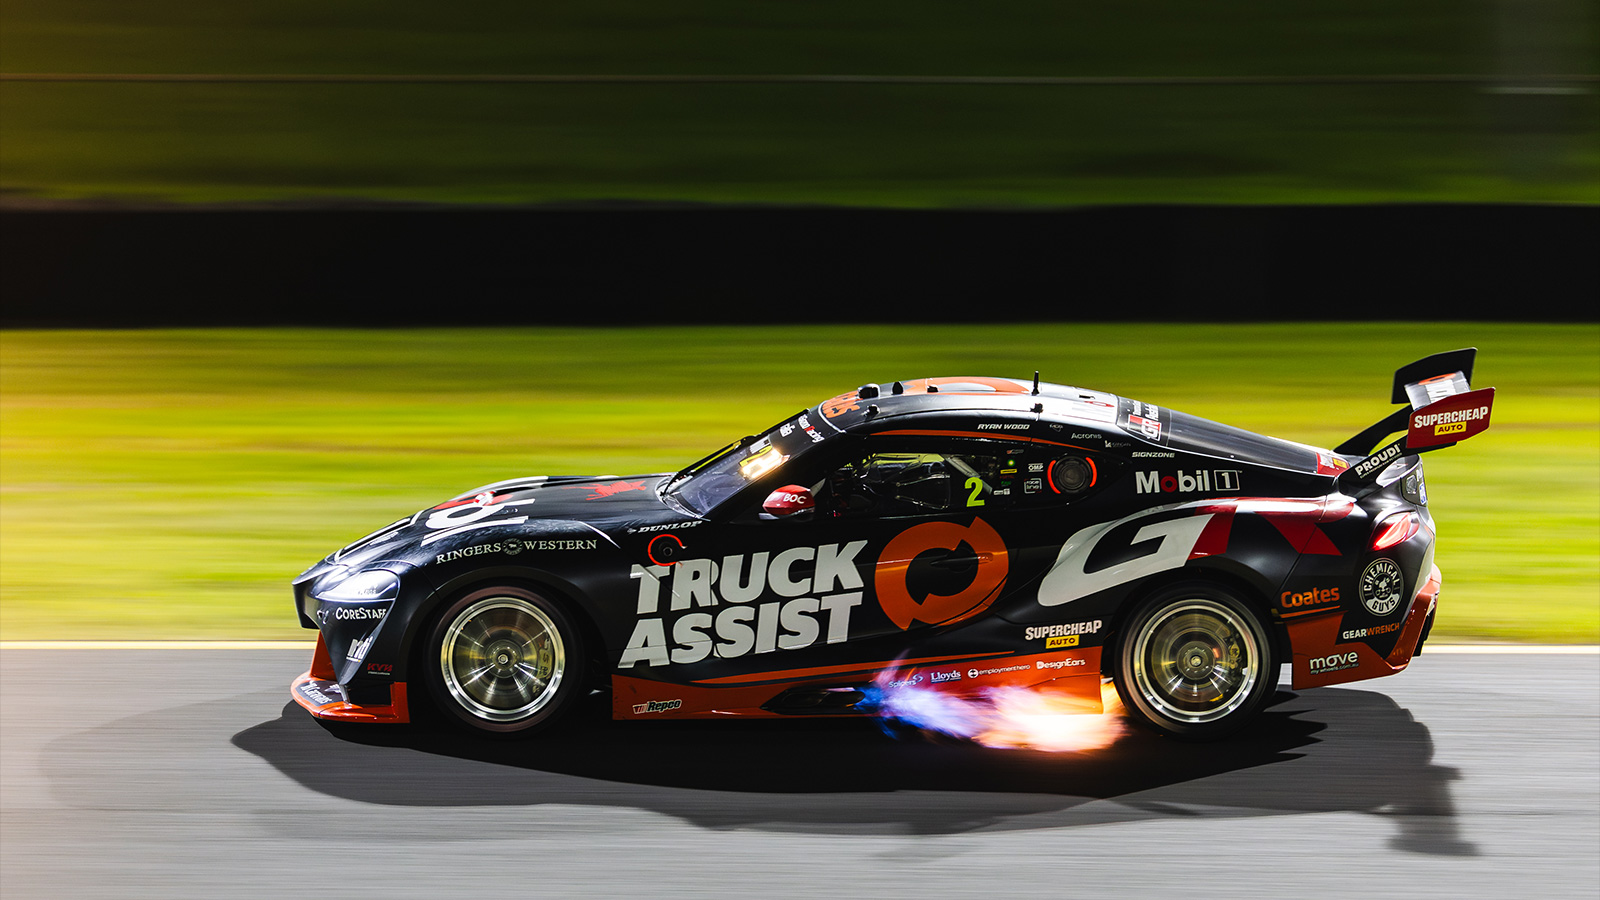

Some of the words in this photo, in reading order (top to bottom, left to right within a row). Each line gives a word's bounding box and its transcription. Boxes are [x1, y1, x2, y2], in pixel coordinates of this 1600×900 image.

[1414, 406, 1488, 428] SUPERCHEAP
[1438, 424, 1463, 433] AUTO
[1354, 444, 1401, 475] PROUDI
[964, 477, 985, 507] 2
[1135, 470, 1210, 494] Mobil
[783, 493, 807, 504] BOC
[638, 521, 703, 533] DUNLOP
[436, 542, 501, 564] RINGERS
[524, 539, 597, 550] WESTERN
[629, 540, 868, 615] TRUCK
[1363, 562, 1400, 592] CHEMICAL
[1281, 587, 1340, 608] Coates
[1372, 597, 1396, 612] GUYS
[617, 591, 863, 668] ASSIST
[1025, 620, 1102, 641] SUPERCHEAP
[1342, 622, 1400, 640] GEARWRENCH
[1049, 637, 1077, 647] AUTO
[1309, 651, 1358, 670] move
[930, 670, 961, 681] Lloyds
[646, 699, 682, 713] Repco
